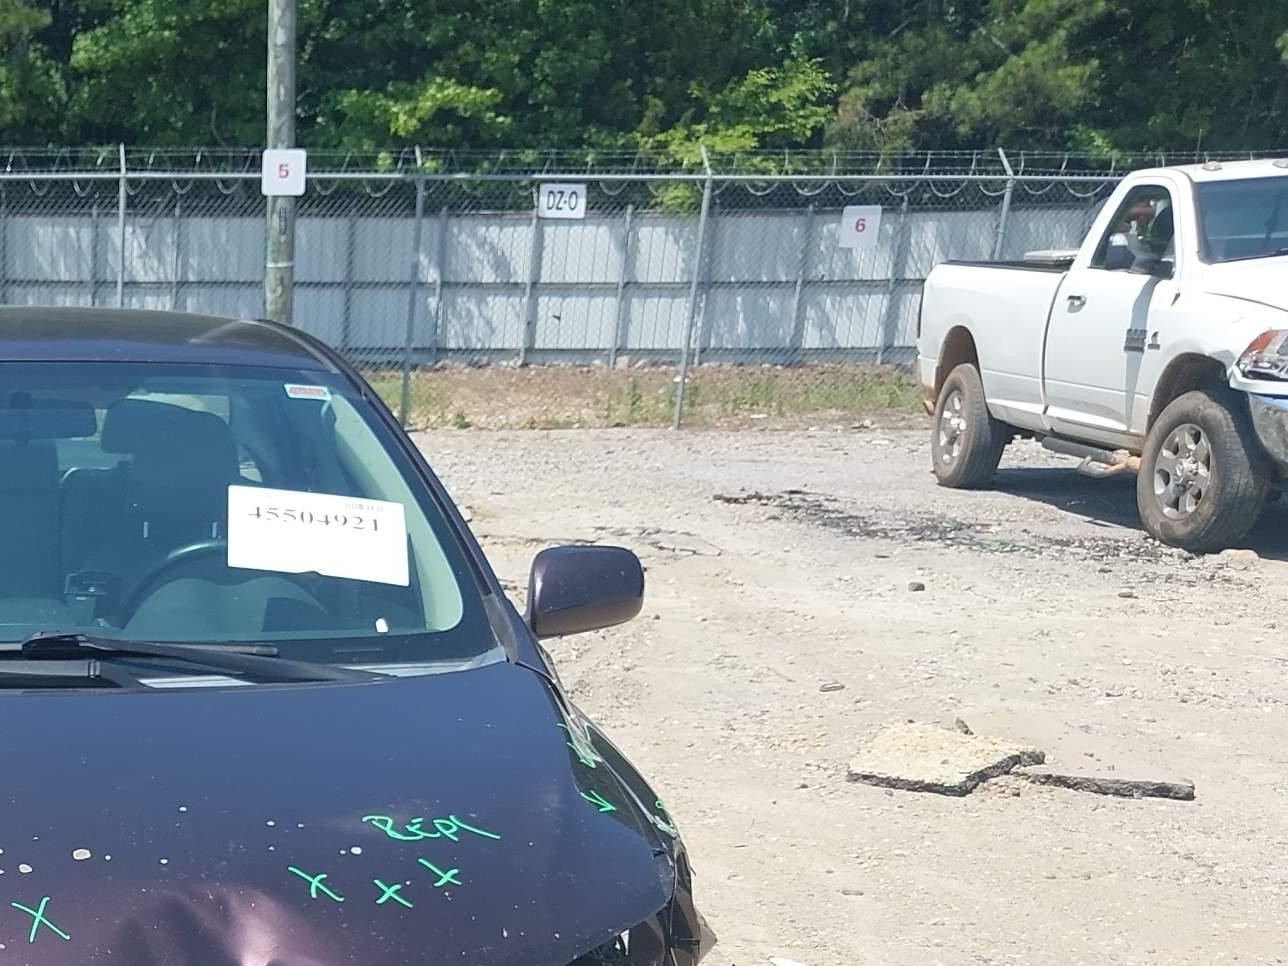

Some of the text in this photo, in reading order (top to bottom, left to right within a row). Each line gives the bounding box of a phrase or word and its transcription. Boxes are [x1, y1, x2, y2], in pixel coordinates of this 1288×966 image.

[278, 163, 290, 179] 5
[855, 218, 866, 233] 6
[248, 504, 380, 532] 45504921
